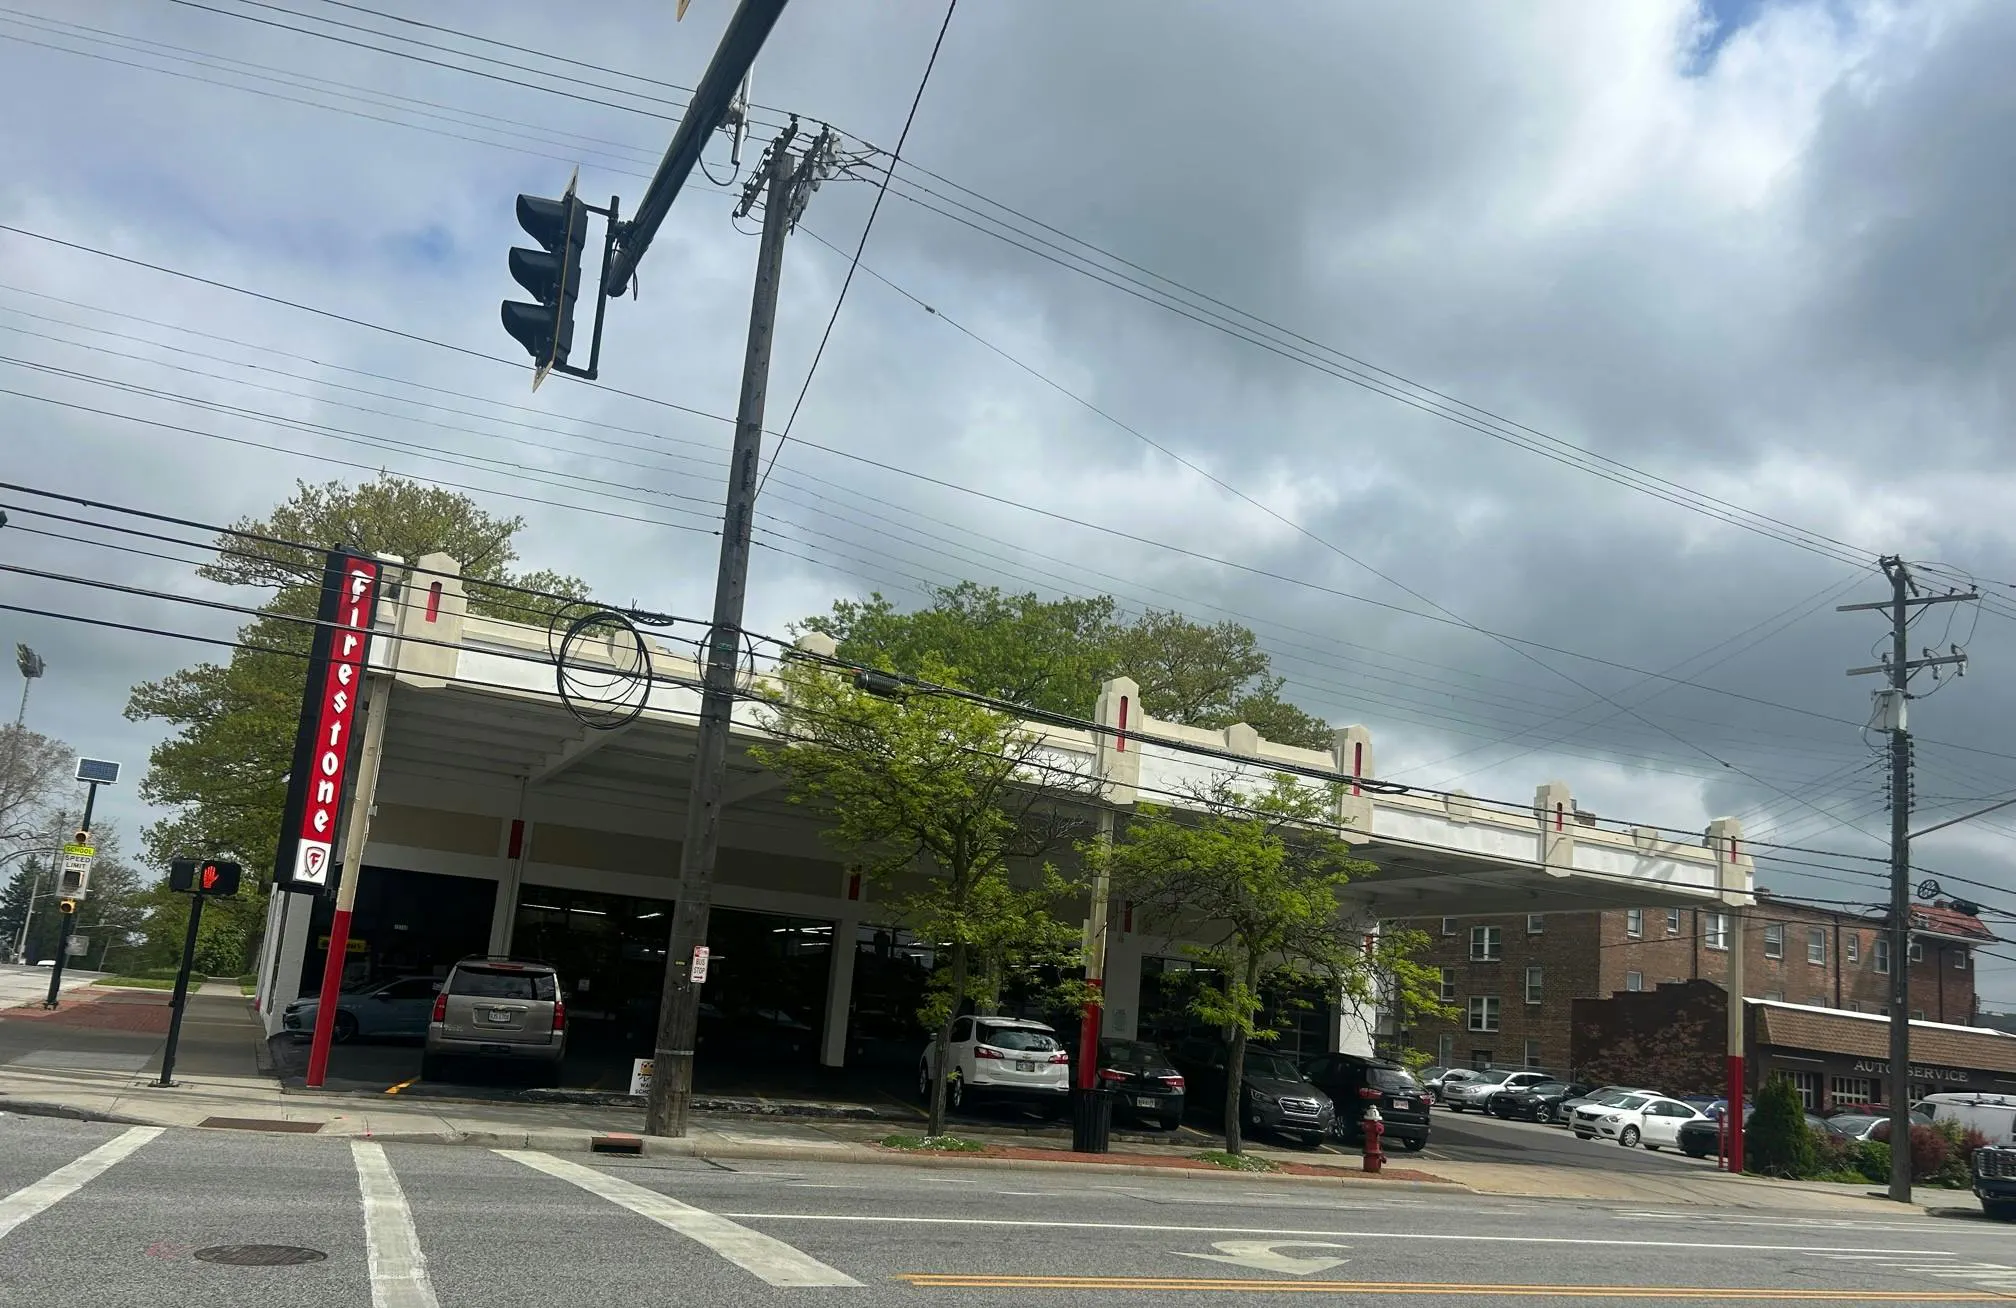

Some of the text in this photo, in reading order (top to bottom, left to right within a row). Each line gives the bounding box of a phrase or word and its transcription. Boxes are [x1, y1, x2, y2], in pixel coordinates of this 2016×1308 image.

[313, 569, 374, 834] Firestone
[66, 846, 92, 855] SCHOOL
[65, 855, 90, 863] SPEED
[693, 966, 705, 974] STOP
[1906, 1066, 1969, 1082] SERVICE
